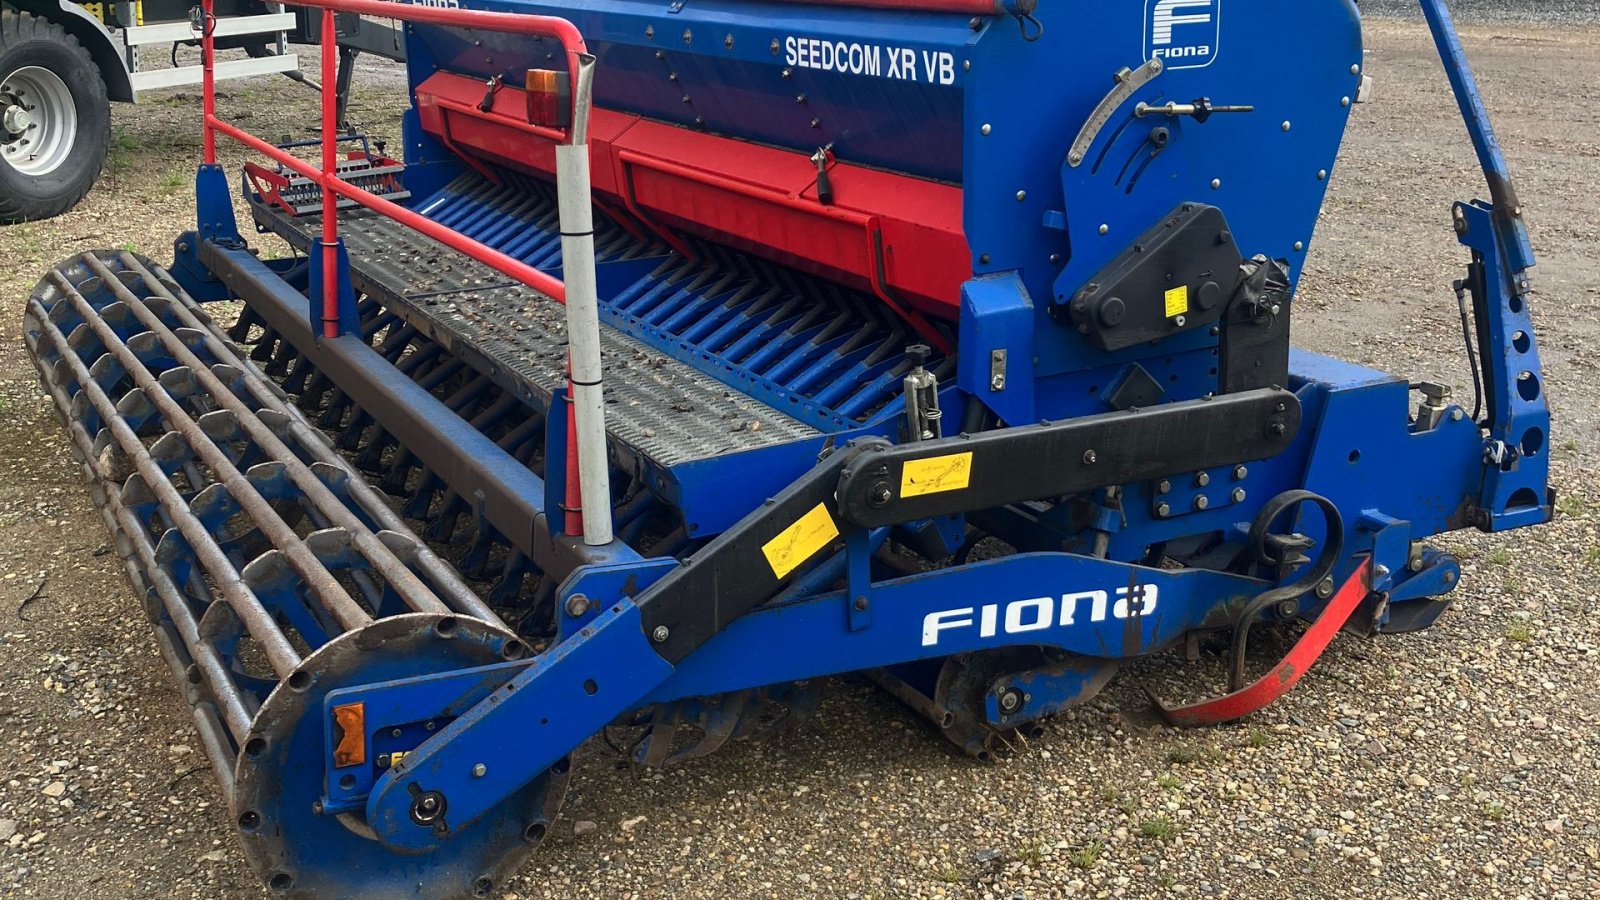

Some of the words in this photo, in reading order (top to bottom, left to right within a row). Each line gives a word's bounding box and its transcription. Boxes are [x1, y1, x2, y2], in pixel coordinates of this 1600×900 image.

[785, 36, 881, 77] SEEDCOM
[886, 46, 917, 81] XR
[922, 50, 955, 85] VB
